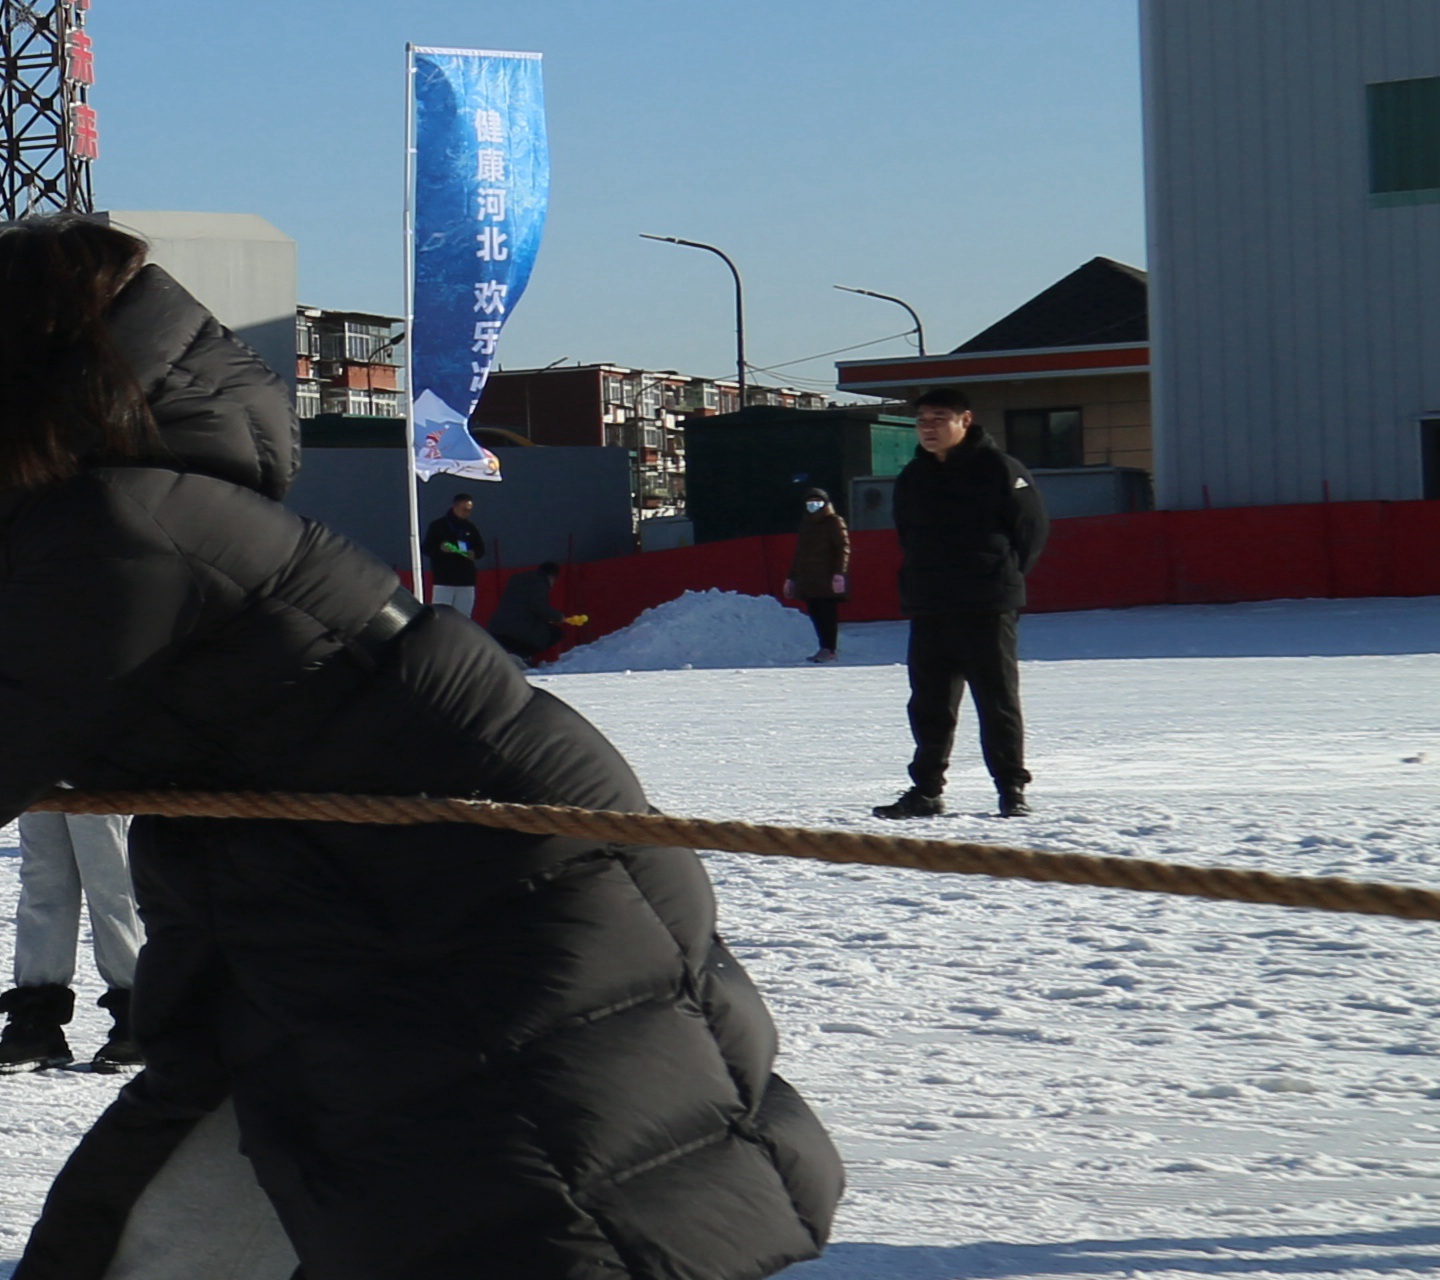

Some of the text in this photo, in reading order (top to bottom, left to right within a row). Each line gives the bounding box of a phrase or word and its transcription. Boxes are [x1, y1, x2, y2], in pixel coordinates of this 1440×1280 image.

[469, 108, 509, 415] 健康河北 欢乐冰
